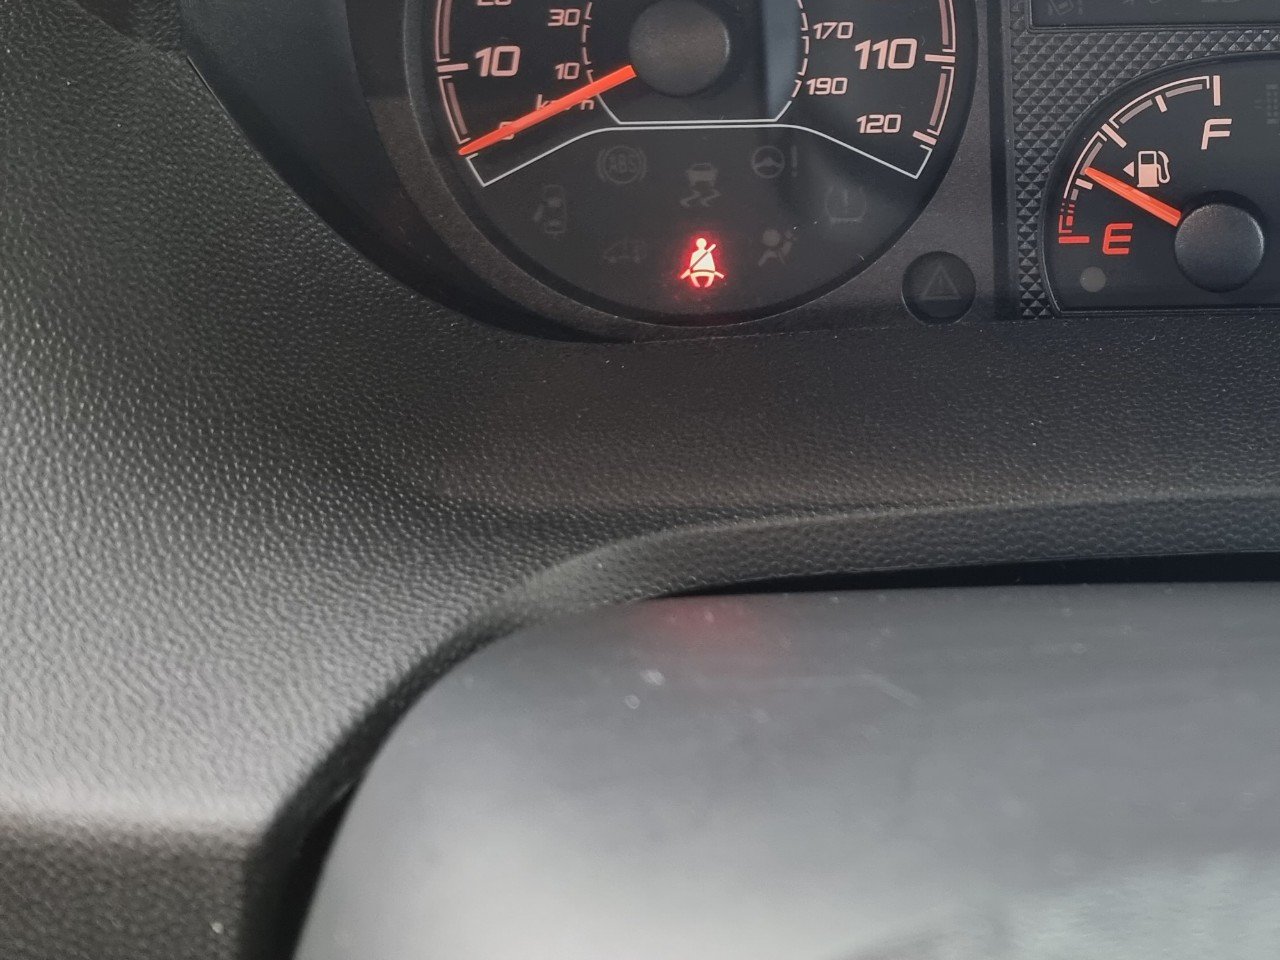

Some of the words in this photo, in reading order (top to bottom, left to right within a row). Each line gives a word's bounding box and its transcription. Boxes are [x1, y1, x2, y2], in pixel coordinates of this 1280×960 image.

[547, 9, 580, 26] 30
[814, 21, 853, 39] 170
[475, 46, 520, 77] 10
[855, 38, 917, 70] 110
[555, 63, 579, 80] 10
[806, 77, 847, 95] 190
[857, 114, 900, 134] 120
[1201, 118, 1232, 150] F
[1102, 223, 1133, 255] E
